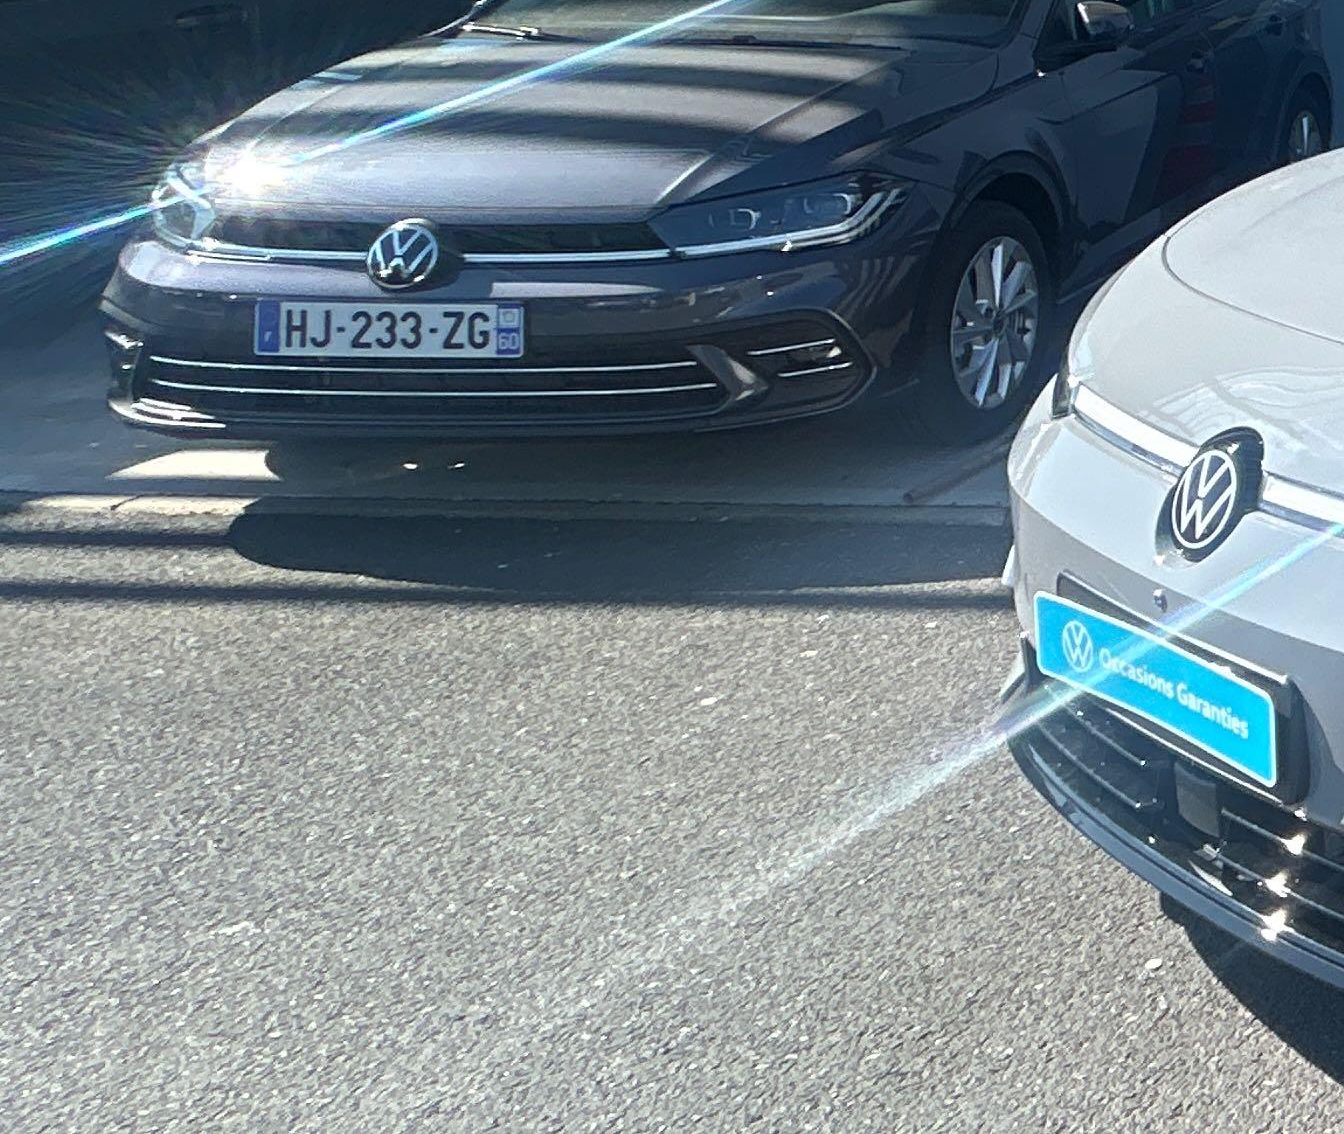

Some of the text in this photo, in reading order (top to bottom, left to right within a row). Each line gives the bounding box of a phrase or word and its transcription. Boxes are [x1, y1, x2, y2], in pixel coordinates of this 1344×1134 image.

[285, 309, 491, 351] HJ-233-ZG
[1099, 646, 1175, 700] Occasions
[1176, 682, 1250, 740] Garanties
